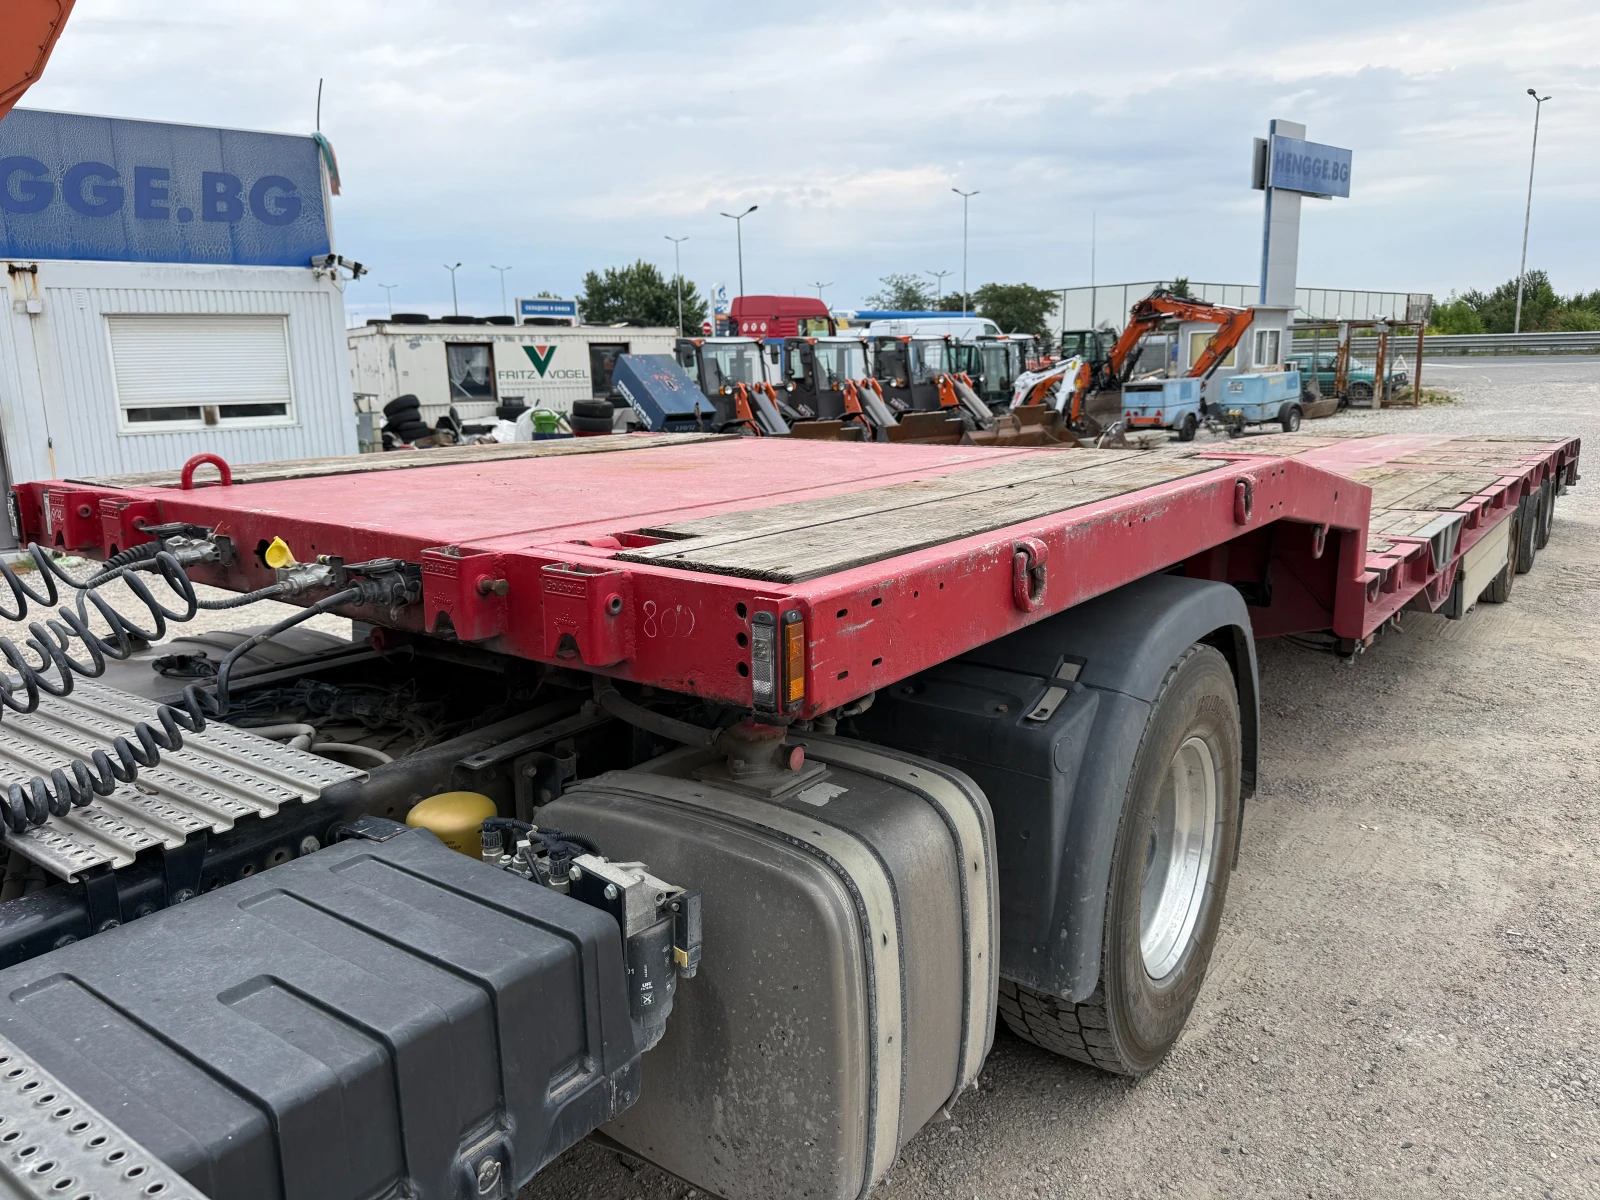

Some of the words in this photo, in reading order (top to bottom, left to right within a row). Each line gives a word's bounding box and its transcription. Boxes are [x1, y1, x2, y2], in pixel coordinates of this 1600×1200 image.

[1274, 150, 1349, 183] HENGGE.BG
[0, 155, 302, 227] GGE.BG
[498, 369, 536, 380] FRITZ
[548, 369, 589, 379] VOGEL
[424, 560, 458, 577] Goldhofer
[545, 578, 585, 596] Goldhofer
